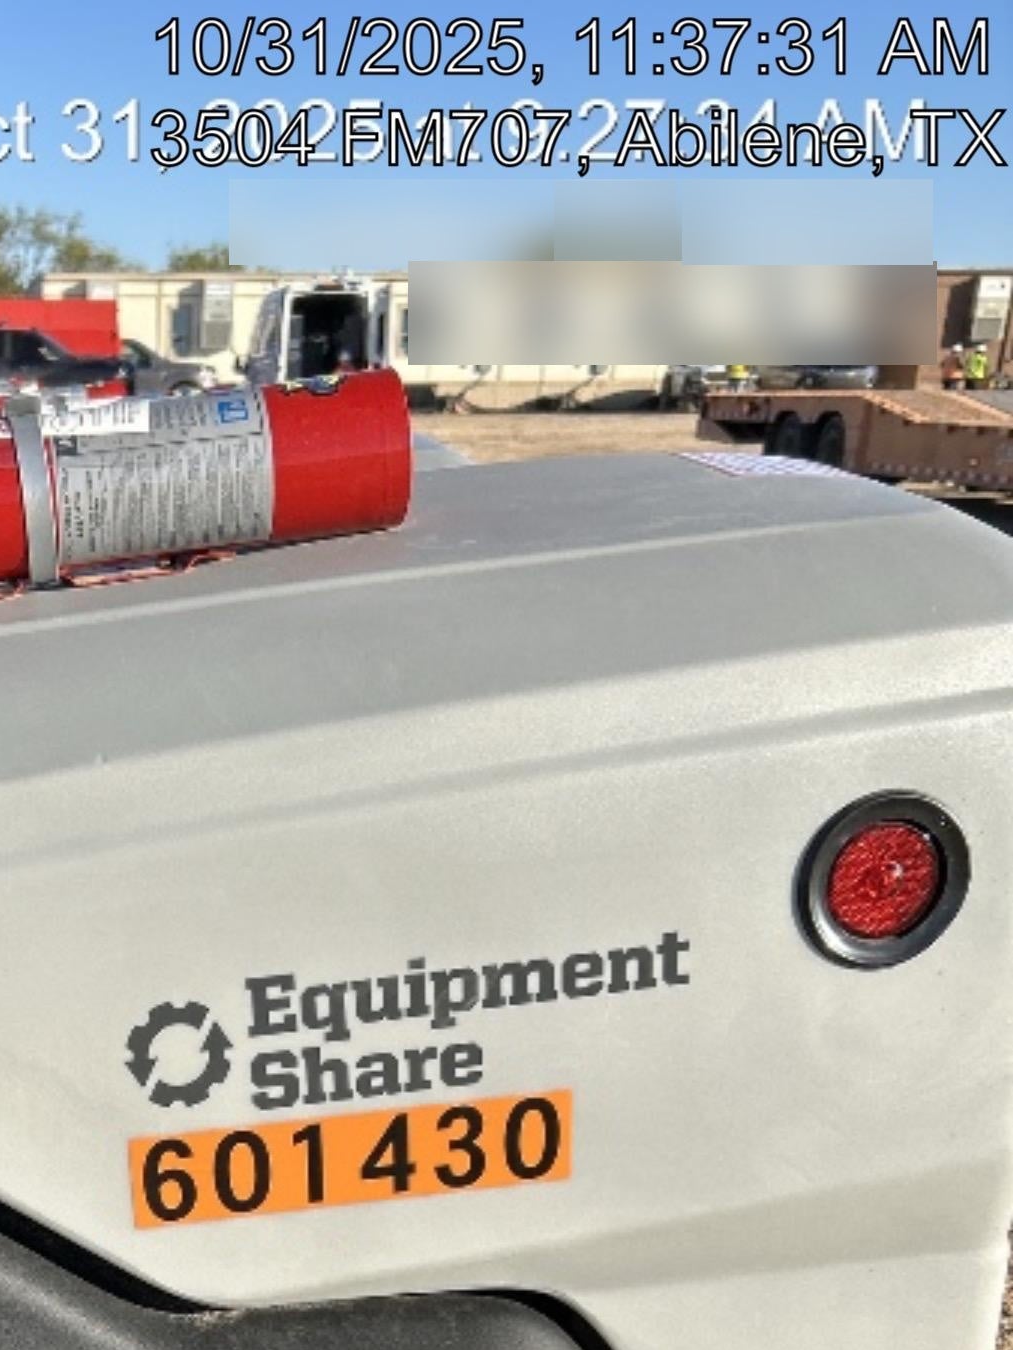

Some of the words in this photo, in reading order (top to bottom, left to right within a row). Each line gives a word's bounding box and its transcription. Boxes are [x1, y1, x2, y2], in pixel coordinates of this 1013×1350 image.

[245, 931, 690, 1043] Equipment
[250, 1041, 484, 1110] Share
[141, 1097, 561, 1222] 601430
